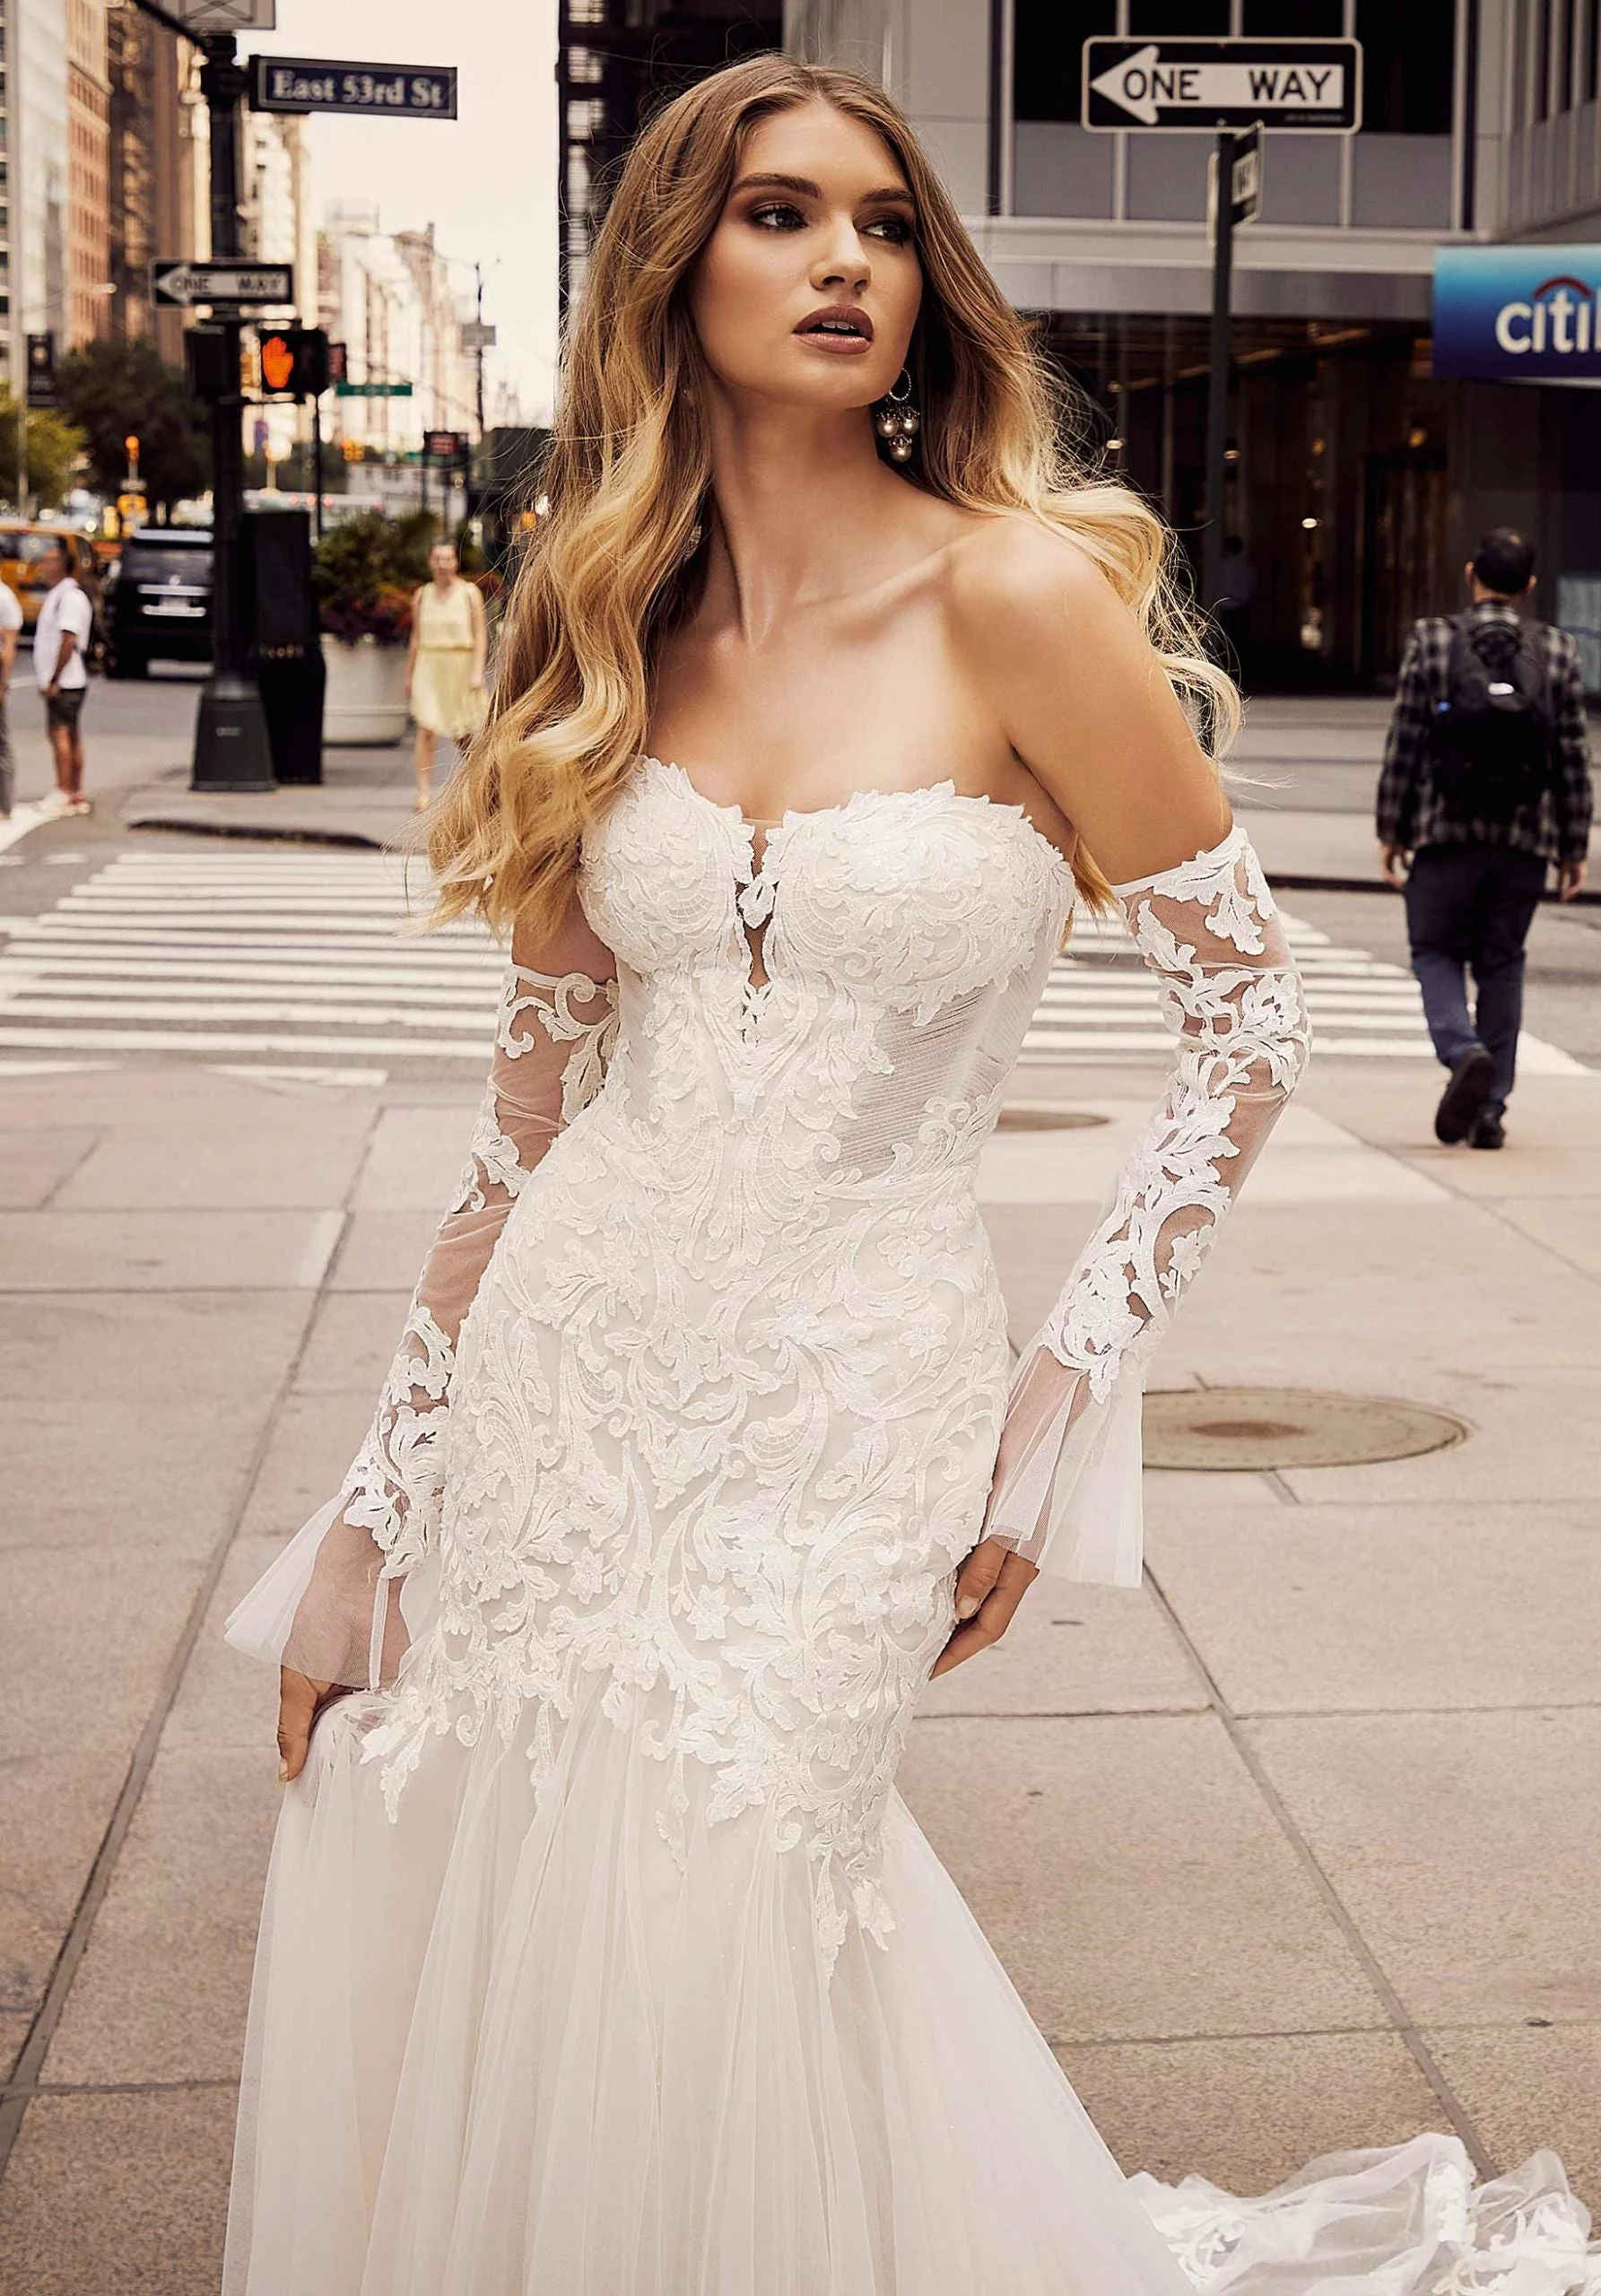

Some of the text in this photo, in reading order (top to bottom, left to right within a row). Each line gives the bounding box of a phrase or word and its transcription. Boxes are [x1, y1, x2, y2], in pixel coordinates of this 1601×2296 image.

[273, 69, 446, 109] East 53rd St
[1123, 69, 1332, 101] ONE WAY
[169, 273, 283, 296] ONE WAY
